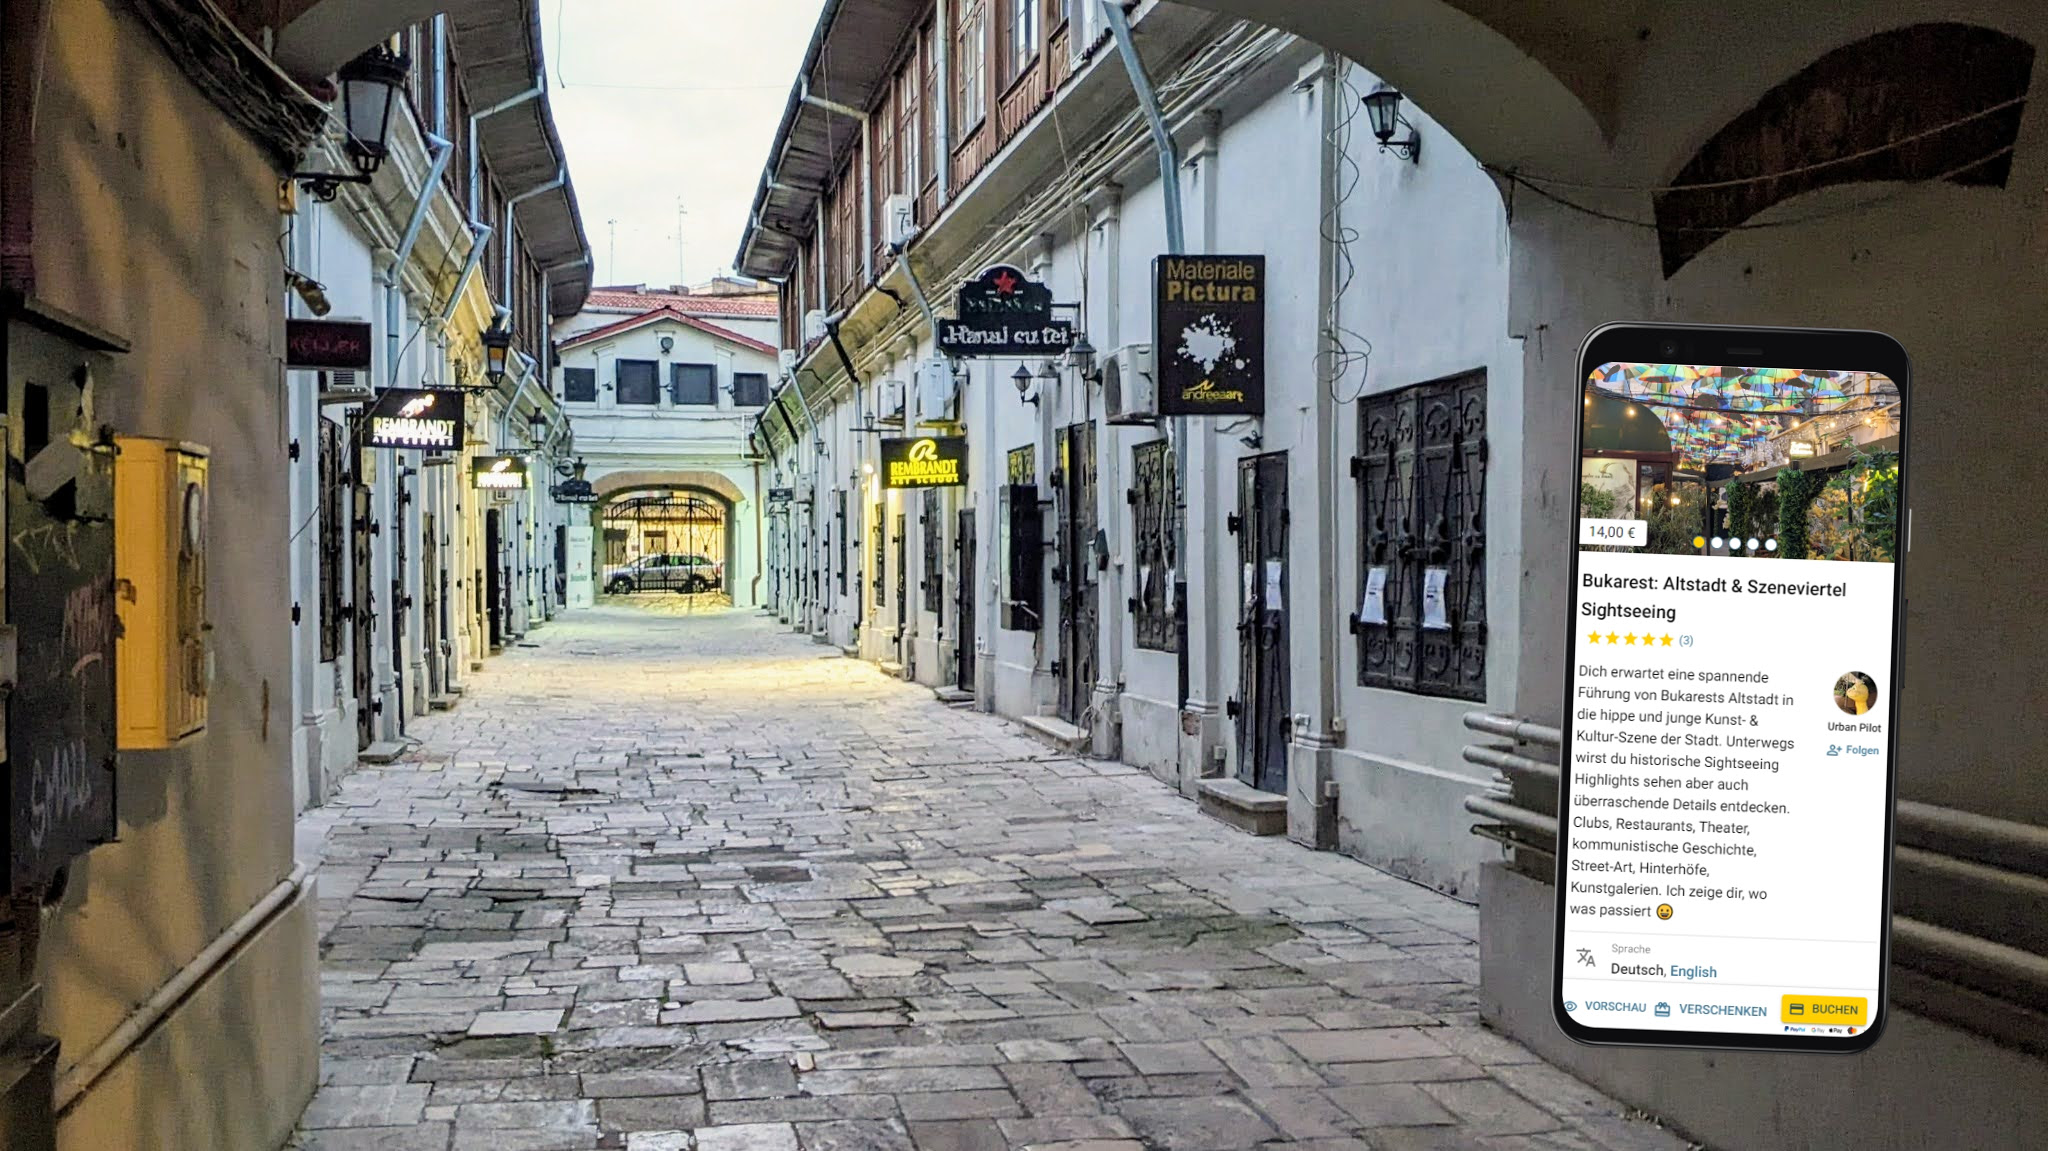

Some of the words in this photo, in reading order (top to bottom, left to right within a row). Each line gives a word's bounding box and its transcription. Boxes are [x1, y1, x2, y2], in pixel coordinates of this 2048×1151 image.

[1167, 258, 1256, 281] Materiale
[1167, 282, 1257, 303] Pictura
[1013, 329, 1039, 345] cu
[1041, 326, 1069, 345] tei
[1182, 385, 1245, 403] andreeaart
[373, 417, 456, 437] REMBRANDT
[890, 459, 958, 476] REMBRANDT
[1589, 525, 1624, 539] 14,00
[1627, 526, 1636, 539] €
[1582, 573, 1658, 590] Bukarest:
[1662, 575, 1727, 593] Altstadt
[1731, 578, 1743, 593] &
[1747, 579, 1847, 597] Szeneviertel
[1581, 601, 1676, 623] Sightseeing
[1678, 634, 1694, 648] (3)
[1579, 664, 1607, 678] Dich
[1610, 667, 1664, 680] erwartet
[1667, 669, 1695, 681] eine
[1698, 671, 1769, 684] spannende
[1578, 686, 1631, 703] Führung
[1634, 691, 1657, 702] von
[1661, 689, 1725, 704] Bukarests
[1728, 692, 1779, 706] Altstadt
[1781, 694, 1794, 706] in
[1577, 707, 1597, 721] die
[1600, 708, 1636, 723] hippe
[1638, 710, 1663, 723] und
[1664, 711, 1702, 727] junge
[1705, 713, 1746, 726] Kunst-
[1749, 714, 1759, 727] &
[1827, 721, 1857, 733] Urban
[1858, 722, 1882, 734] Pilot
[1576, 729, 1657, 745] Kultur-Szene
[1660, 732, 1682, 745] der
[1684, 733, 1722, 747] Stadt.
[1726, 735, 1795, 752] Unterwegs
[1846, 744, 1880, 757] Folgen
[1575, 751, 1607, 764] wirst
[1610, 752, 1627, 765] du
[1630, 752, 1701, 768] historische
[1704, 756, 1779, 774] Sightseeing
[1575, 773, 1640, 789] Highlights
[1643, 775, 1682, 789] sehen
[1685, 777, 1714, 790] aber
[1717, 778, 1749, 791] auch
[1574, 794, 1670, 810] überraschende
[1673, 798, 1717, 812] Details
[1720, 801, 1790, 814] entdecken.
[1573, 815, 1613, 831] Clubs,
[1616, 817, 1696, 834] Restaurants,
[1699, 820, 1751, 836] Theater,
[1572, 837, 1679, 854] kommunistische
[1682, 841, 1757, 858] Geschichte,
[1571, 859, 1636, 875] Street-Art,
[1639, 862, 1710, 878] Hinterhöfe,
[1570, 880, 1662, 897] Kunstgalerien.
[1666, 884, 1685, 897] Ich
[1688, 886, 1723, 901] zeige
[1726, 886, 1745, 901] dir,
[1748, 890, 1768, 900] wo
[1570, 904, 1596, 917] was
[1599, 904, 1652, 919] passiert
[1611, 943, 1651, 956] Sprache
[1611, 962, 1667, 978] Deutsch,
[1670, 965, 1717, 980] English
[1585, 1001, 1647, 1013] VORSCHAU
[1679, 1003, 1767, 1017] VERSCHENKEN
[1812, 1003, 1859, 1016] BUCHEN
